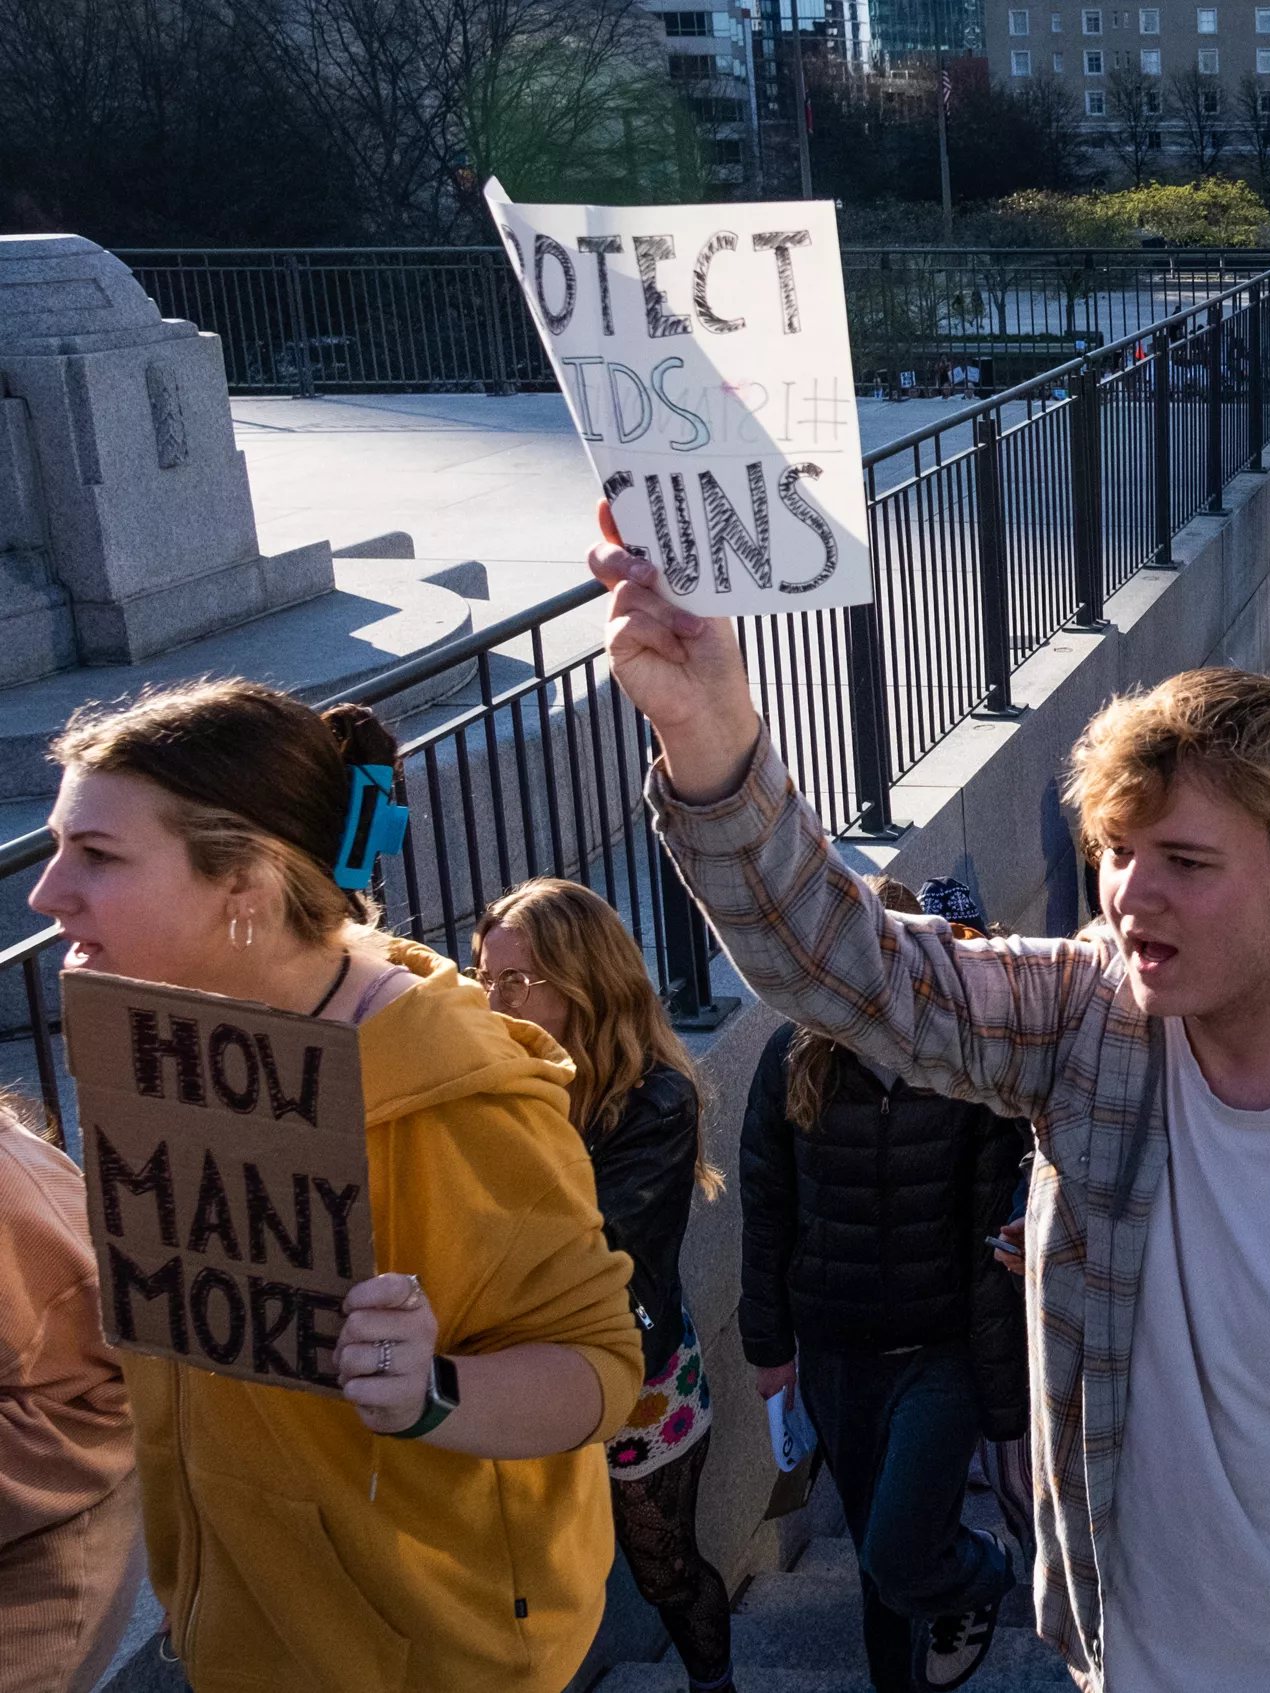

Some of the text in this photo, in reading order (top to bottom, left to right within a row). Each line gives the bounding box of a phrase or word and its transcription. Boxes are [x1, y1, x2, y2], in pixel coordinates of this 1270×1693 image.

[127, 1006, 323, 1128] HOW
[94, 1123, 361, 1279] MANY
[107, 1242, 346, 1390] MORE
